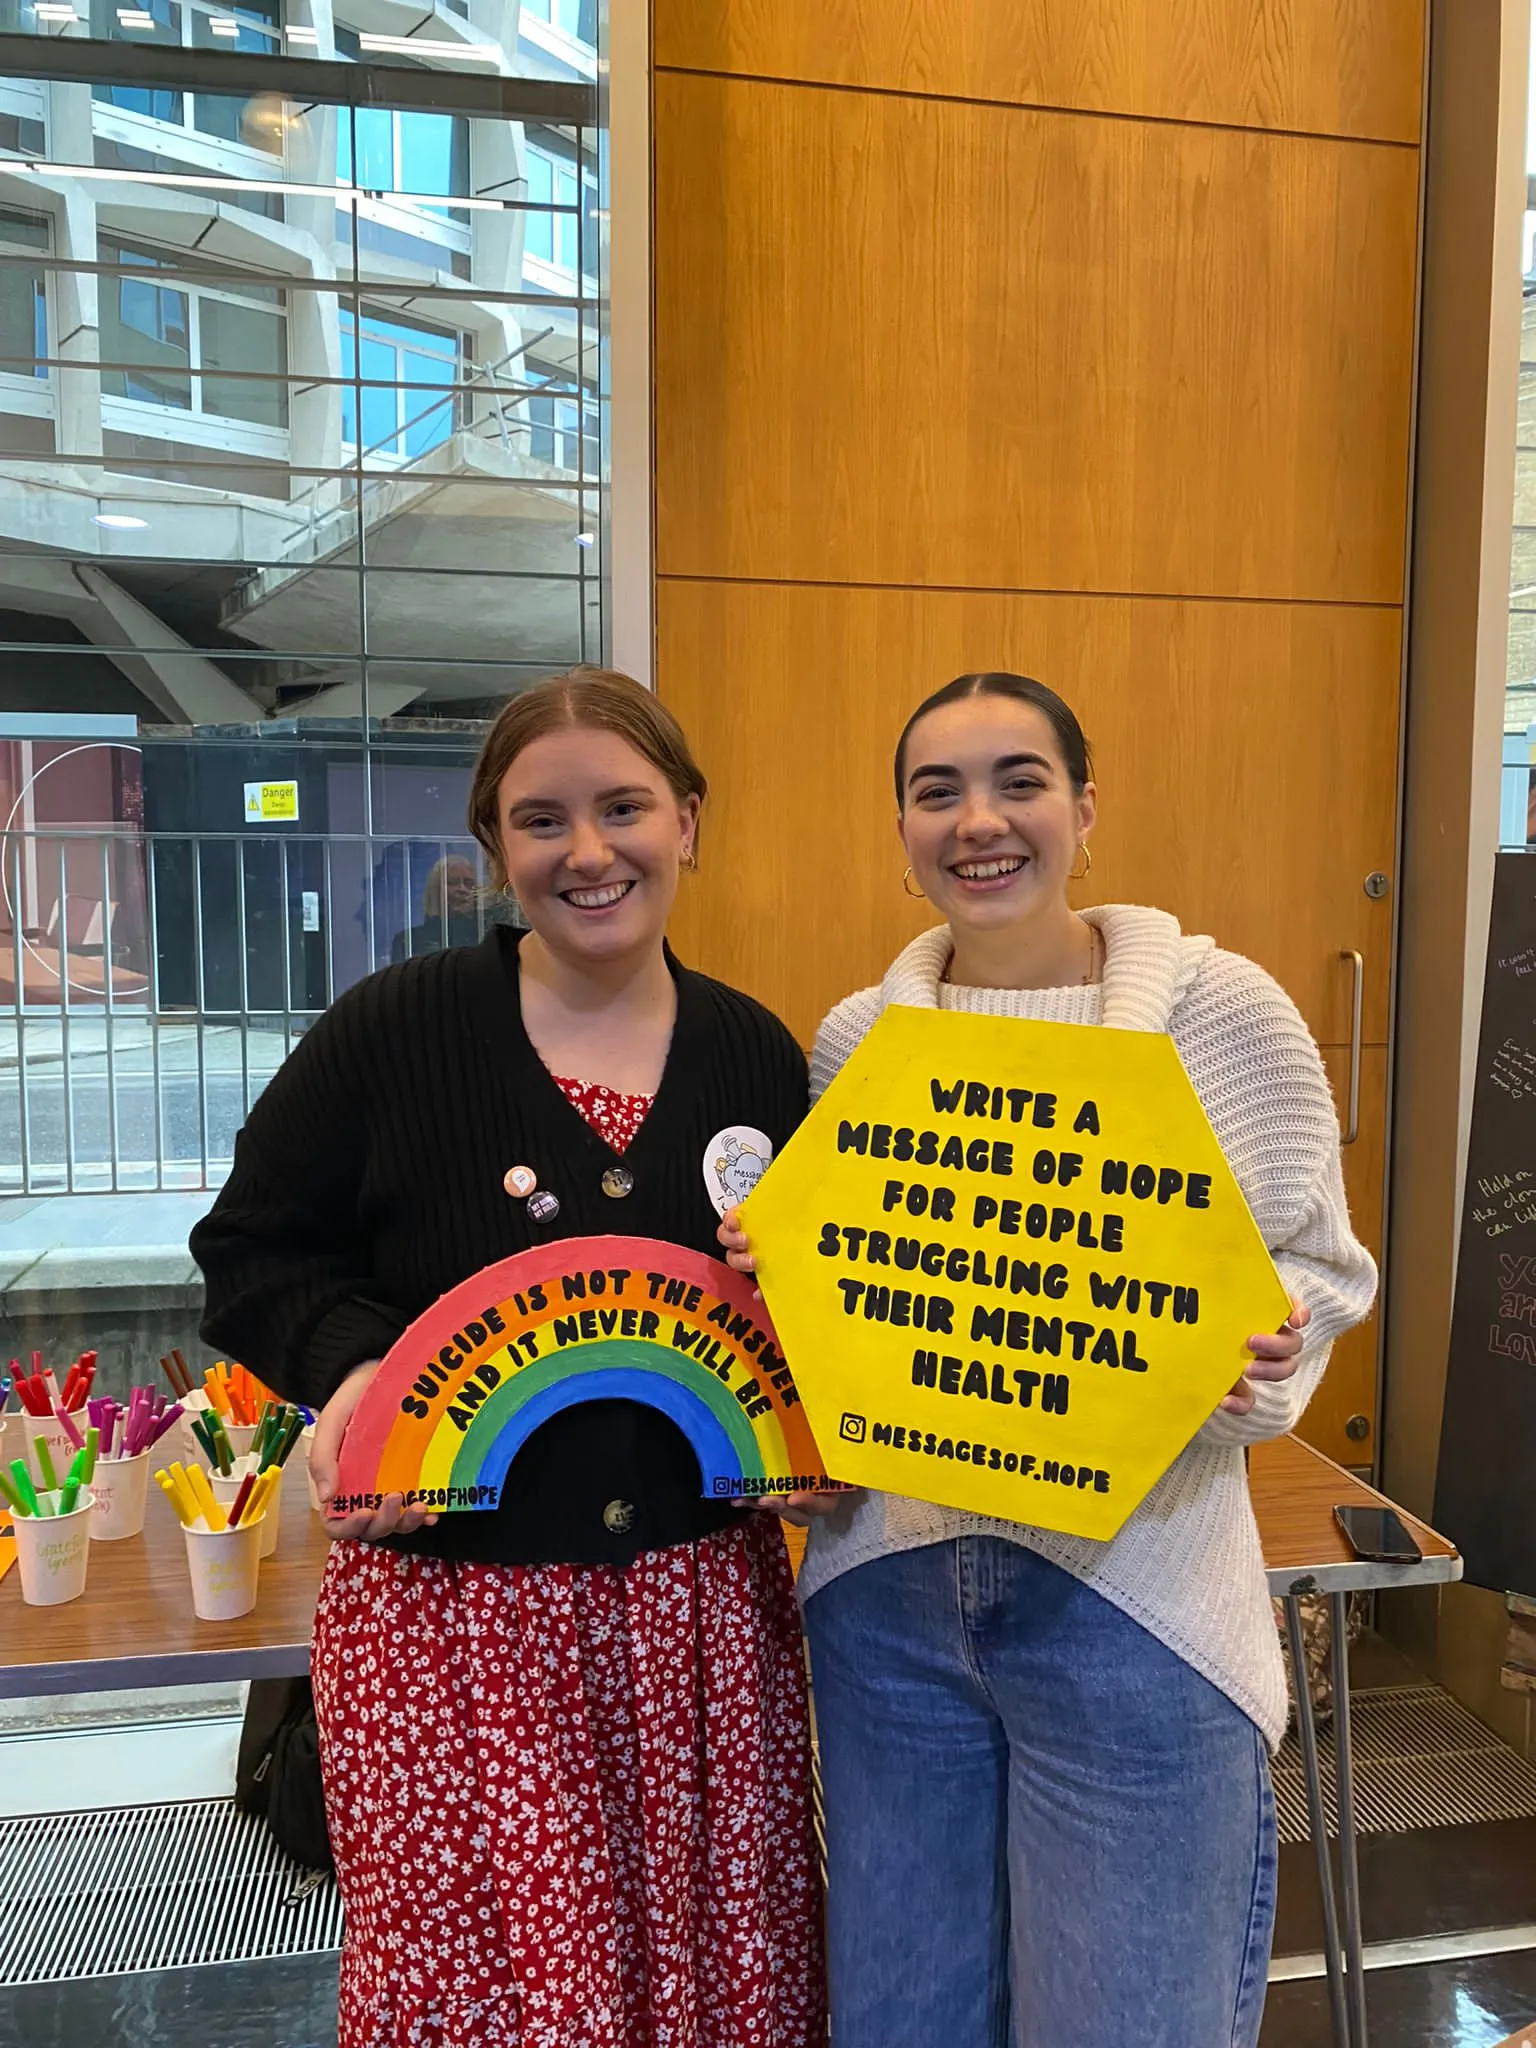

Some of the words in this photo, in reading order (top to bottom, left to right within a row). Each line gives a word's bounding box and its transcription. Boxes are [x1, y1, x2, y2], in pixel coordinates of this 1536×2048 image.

[262, 787, 294, 799] Danger
[930, 1078, 1057, 1129] WRITE
[1073, 1100, 1100, 1136] A
[837, 1119, 1014, 1176] MESSAGE
[1032, 1149, 1083, 1187] OF
[1101, 1159, 1212, 1209] HOPE
[882, 1180, 956, 1222] FOR
[973, 1195, 1124, 1253] PEOPLE
[817, 1222, 1069, 1300] STRUGGLING
[1089, 1271, 1199, 1325] WITH
[401, 1306, 506, 1420] SUICIDE
[513, 1284, 548, 1316] IS
[561, 1269, 631, 1301] NOT
[646, 1272, 704, 1313] THE
[837, 1278, 954, 1335] THEIR
[970, 1305, 1148, 1373] MENTAL
[446, 1364, 501, 1431] AND
[507, 1331, 539, 1368] IT
[553, 1308, 660, 1347] NEVER
[672, 1320, 737, 1382] WILL
[735, 1378, 773, 1420] BE
[911, 1349, 1070, 1416] HEALTH
[872, 1422, 1110, 1494] MESSAGESOF.HOPE
